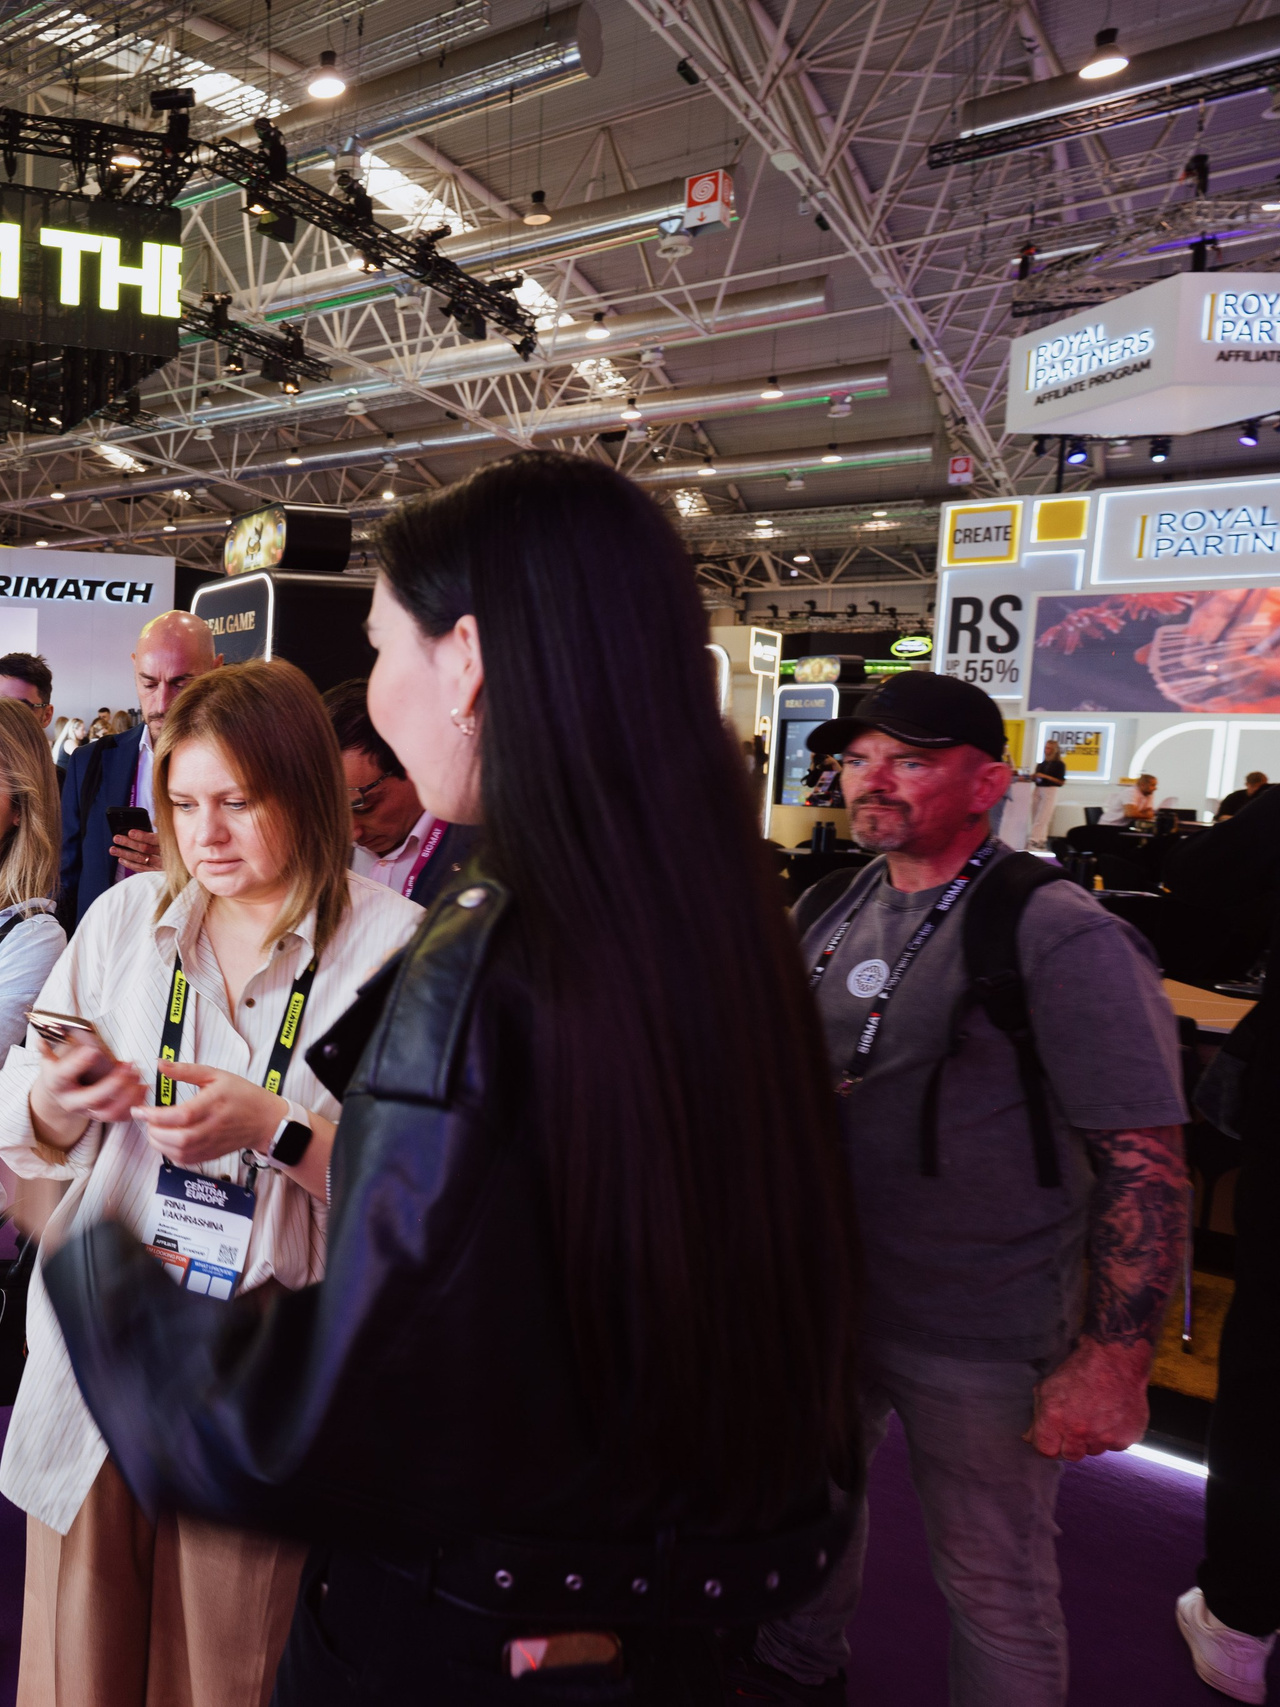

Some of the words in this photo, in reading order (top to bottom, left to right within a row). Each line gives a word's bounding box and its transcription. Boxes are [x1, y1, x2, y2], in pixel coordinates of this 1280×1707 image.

[1221, 292, 1280, 315] ROY
[1220, 320, 1280, 341] PAR
[1035, 324, 1107, 366] ROYAL
[1034, 329, 1154, 390] PARTNERS
[1034, 380, 1086, 406] AFFILIATE
[1089, 359, 1152, 390] PROGRAM
[1157, 505, 1279, 534] ROYAL
[953, 525, 1012, 543] CREATE
[226, 610, 256, 633] GAME
[947, 594, 1023, 654] RS
[946, 660, 960, 671] UP
[964, 658, 1019, 683] 55%
[1051, 730, 1102, 746] DIRECT
[884, 950, 915, 992] Payment
[906, 921, 936, 951] Center
[184, 1180, 228, 1201] CENTRAL
[185, 1189, 225, 1208] EUROPE
[163, 1199, 187, 1212] IRINA
